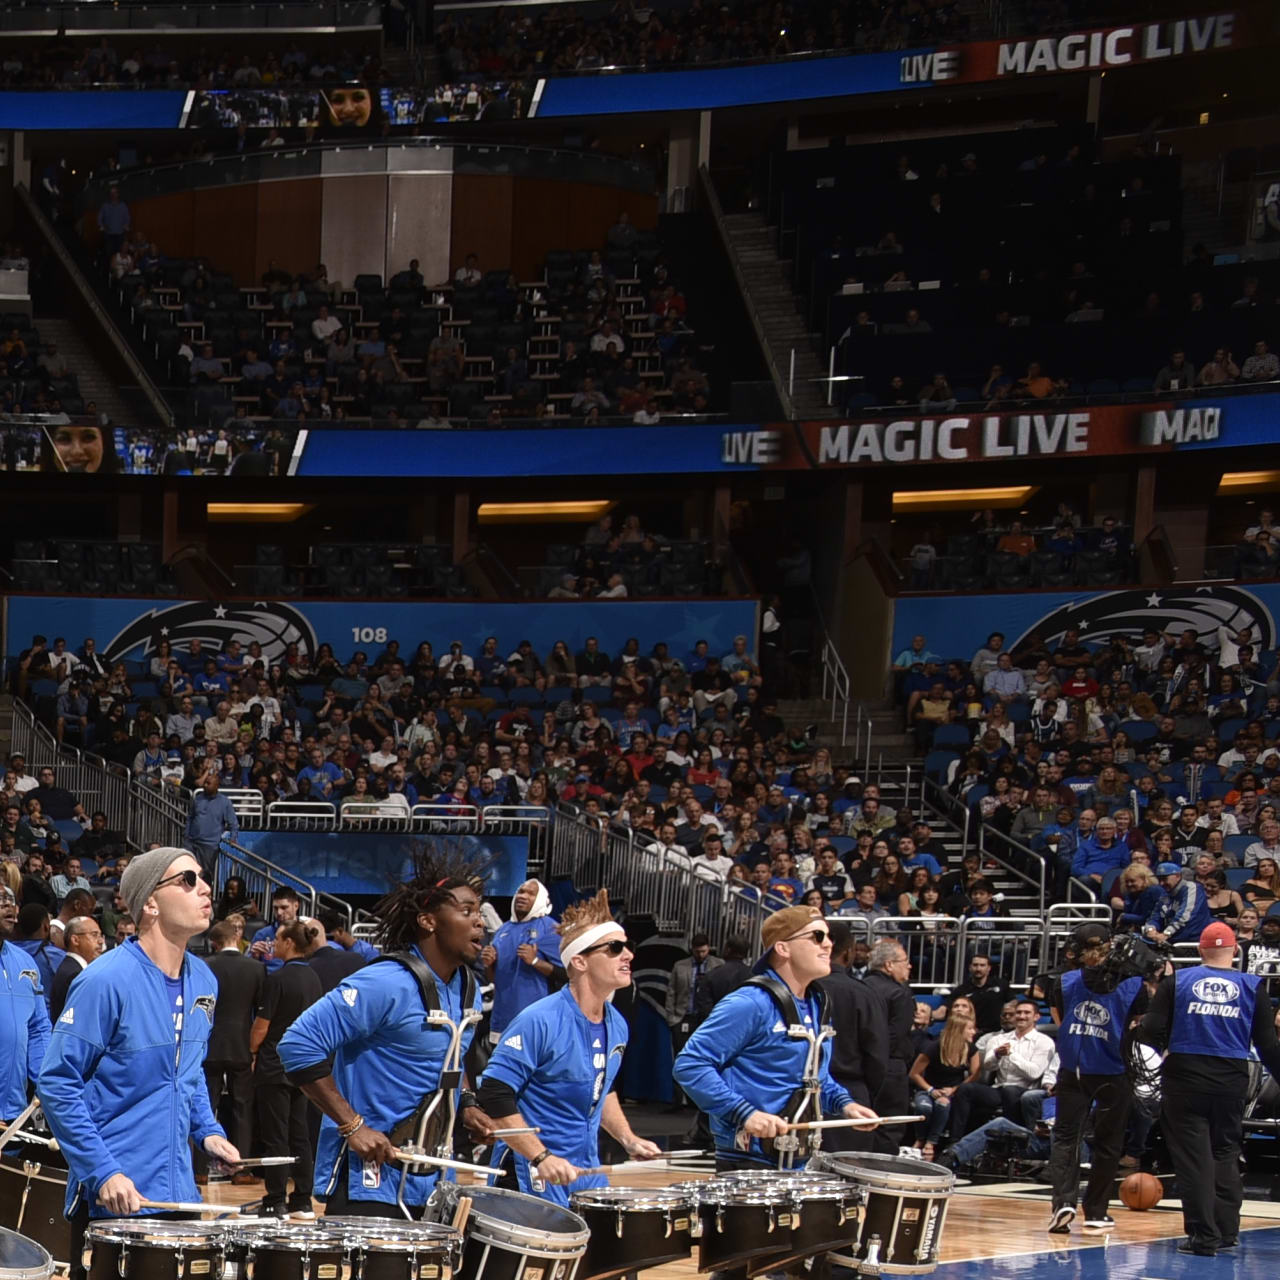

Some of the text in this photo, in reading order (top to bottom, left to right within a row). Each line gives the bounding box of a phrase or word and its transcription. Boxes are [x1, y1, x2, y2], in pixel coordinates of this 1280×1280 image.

[997, 28, 1133, 75] MAGIC
[1144, 13, 1235, 58] LIVE
[819, 418, 971, 463] MAGIC
[982, 412, 1090, 458] LIVE
[351, 627, 387, 643] 108
[1204, 982, 1229, 994] FOX
[1187, 1001, 1241, 1018] FLORIDA
[921, 1216, 938, 1261] YAMAHA
